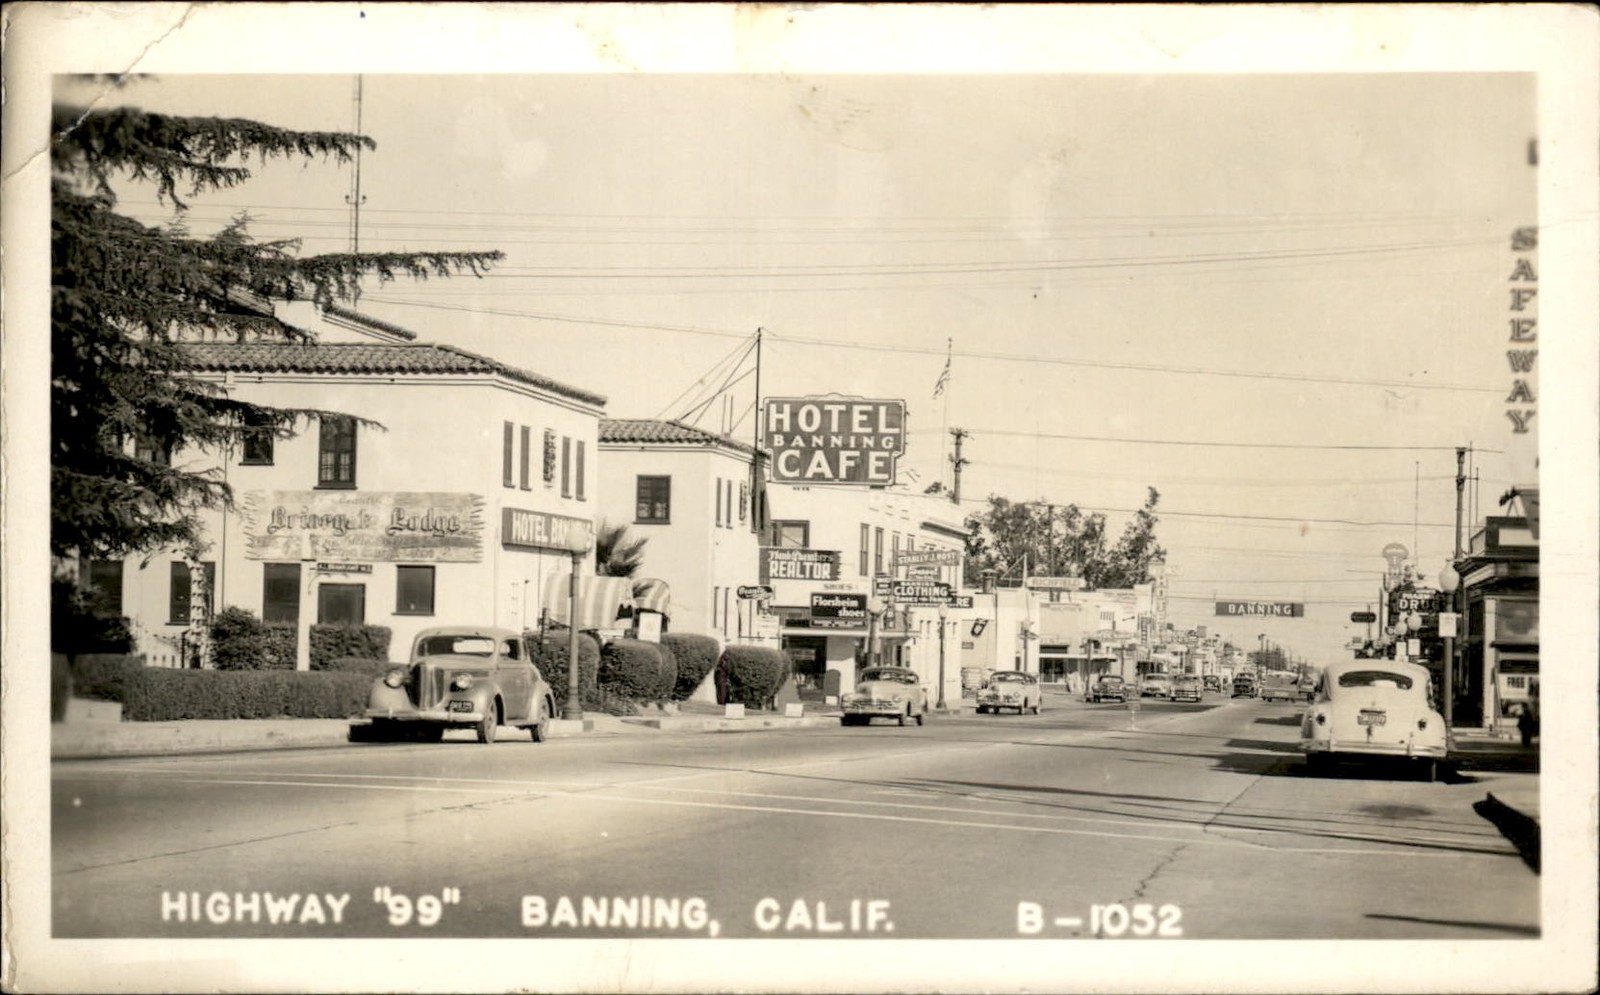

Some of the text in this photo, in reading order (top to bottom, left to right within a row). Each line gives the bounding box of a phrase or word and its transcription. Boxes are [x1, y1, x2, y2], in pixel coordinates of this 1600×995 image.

[1505, 226, 1538, 434] SAFEWAY
[769, 404, 900, 433] HOTEL
[773, 435, 894, 449] BANNING
[778, 450, 890, 479] CAFE
[385, 506, 462, 537] Lodge
[512, 512, 548, 543] HOTEL
[769, 561, 831, 579] REALTOR
[894, 586, 948, 597] CLOTHING
[812, 596, 858, 606] Florsheim
[1228, 603, 1292, 615] BANNING
[838, 607, 865, 617] shoes
